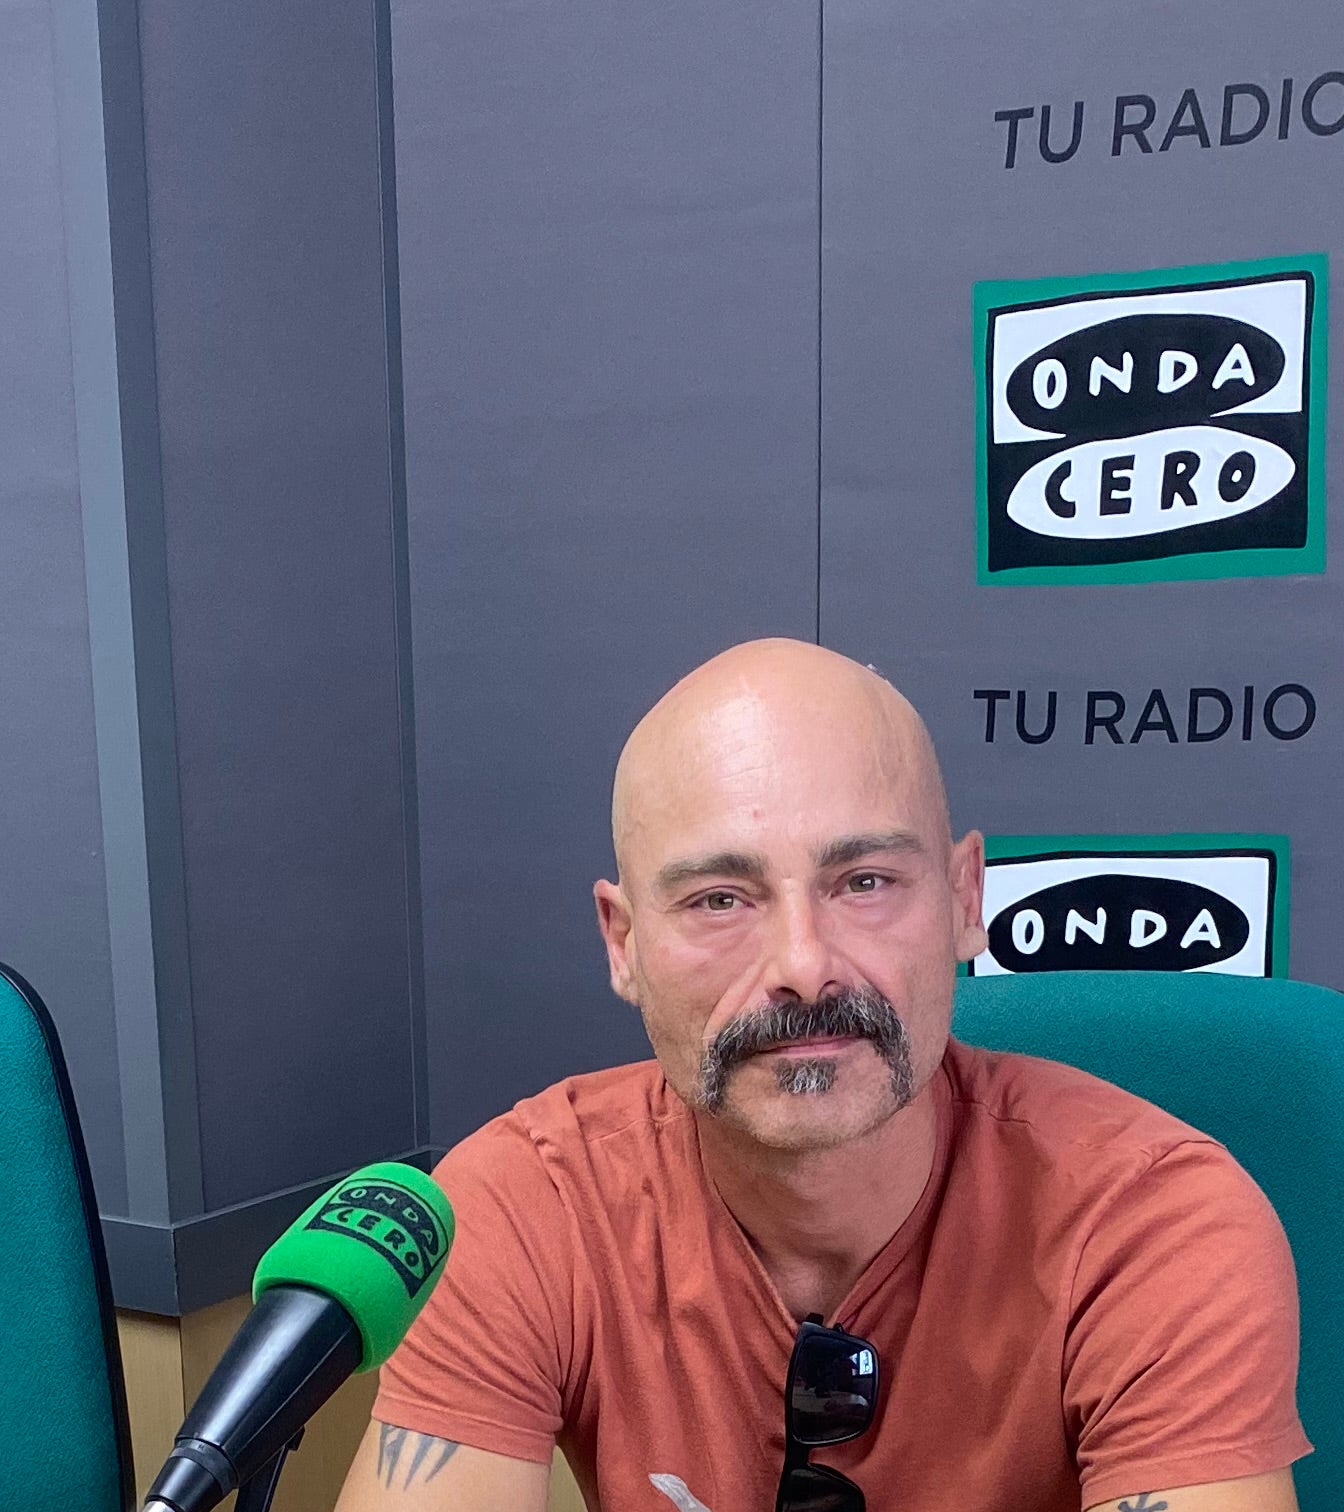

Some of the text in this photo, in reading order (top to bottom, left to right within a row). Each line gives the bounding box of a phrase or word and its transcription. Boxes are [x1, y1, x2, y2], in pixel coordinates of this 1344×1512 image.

[994, 101, 1084, 170] TU
[1032, 342, 1255, 410] ONDA
[1044, 450, 1256, 519] CERO
[973, 683, 1317, 745] TU RADIO
[1011, 906, 1221, 955] ONDA
[337, 1209, 419, 1267] CERO
[350, 1188, 433, 1246] ONDA
